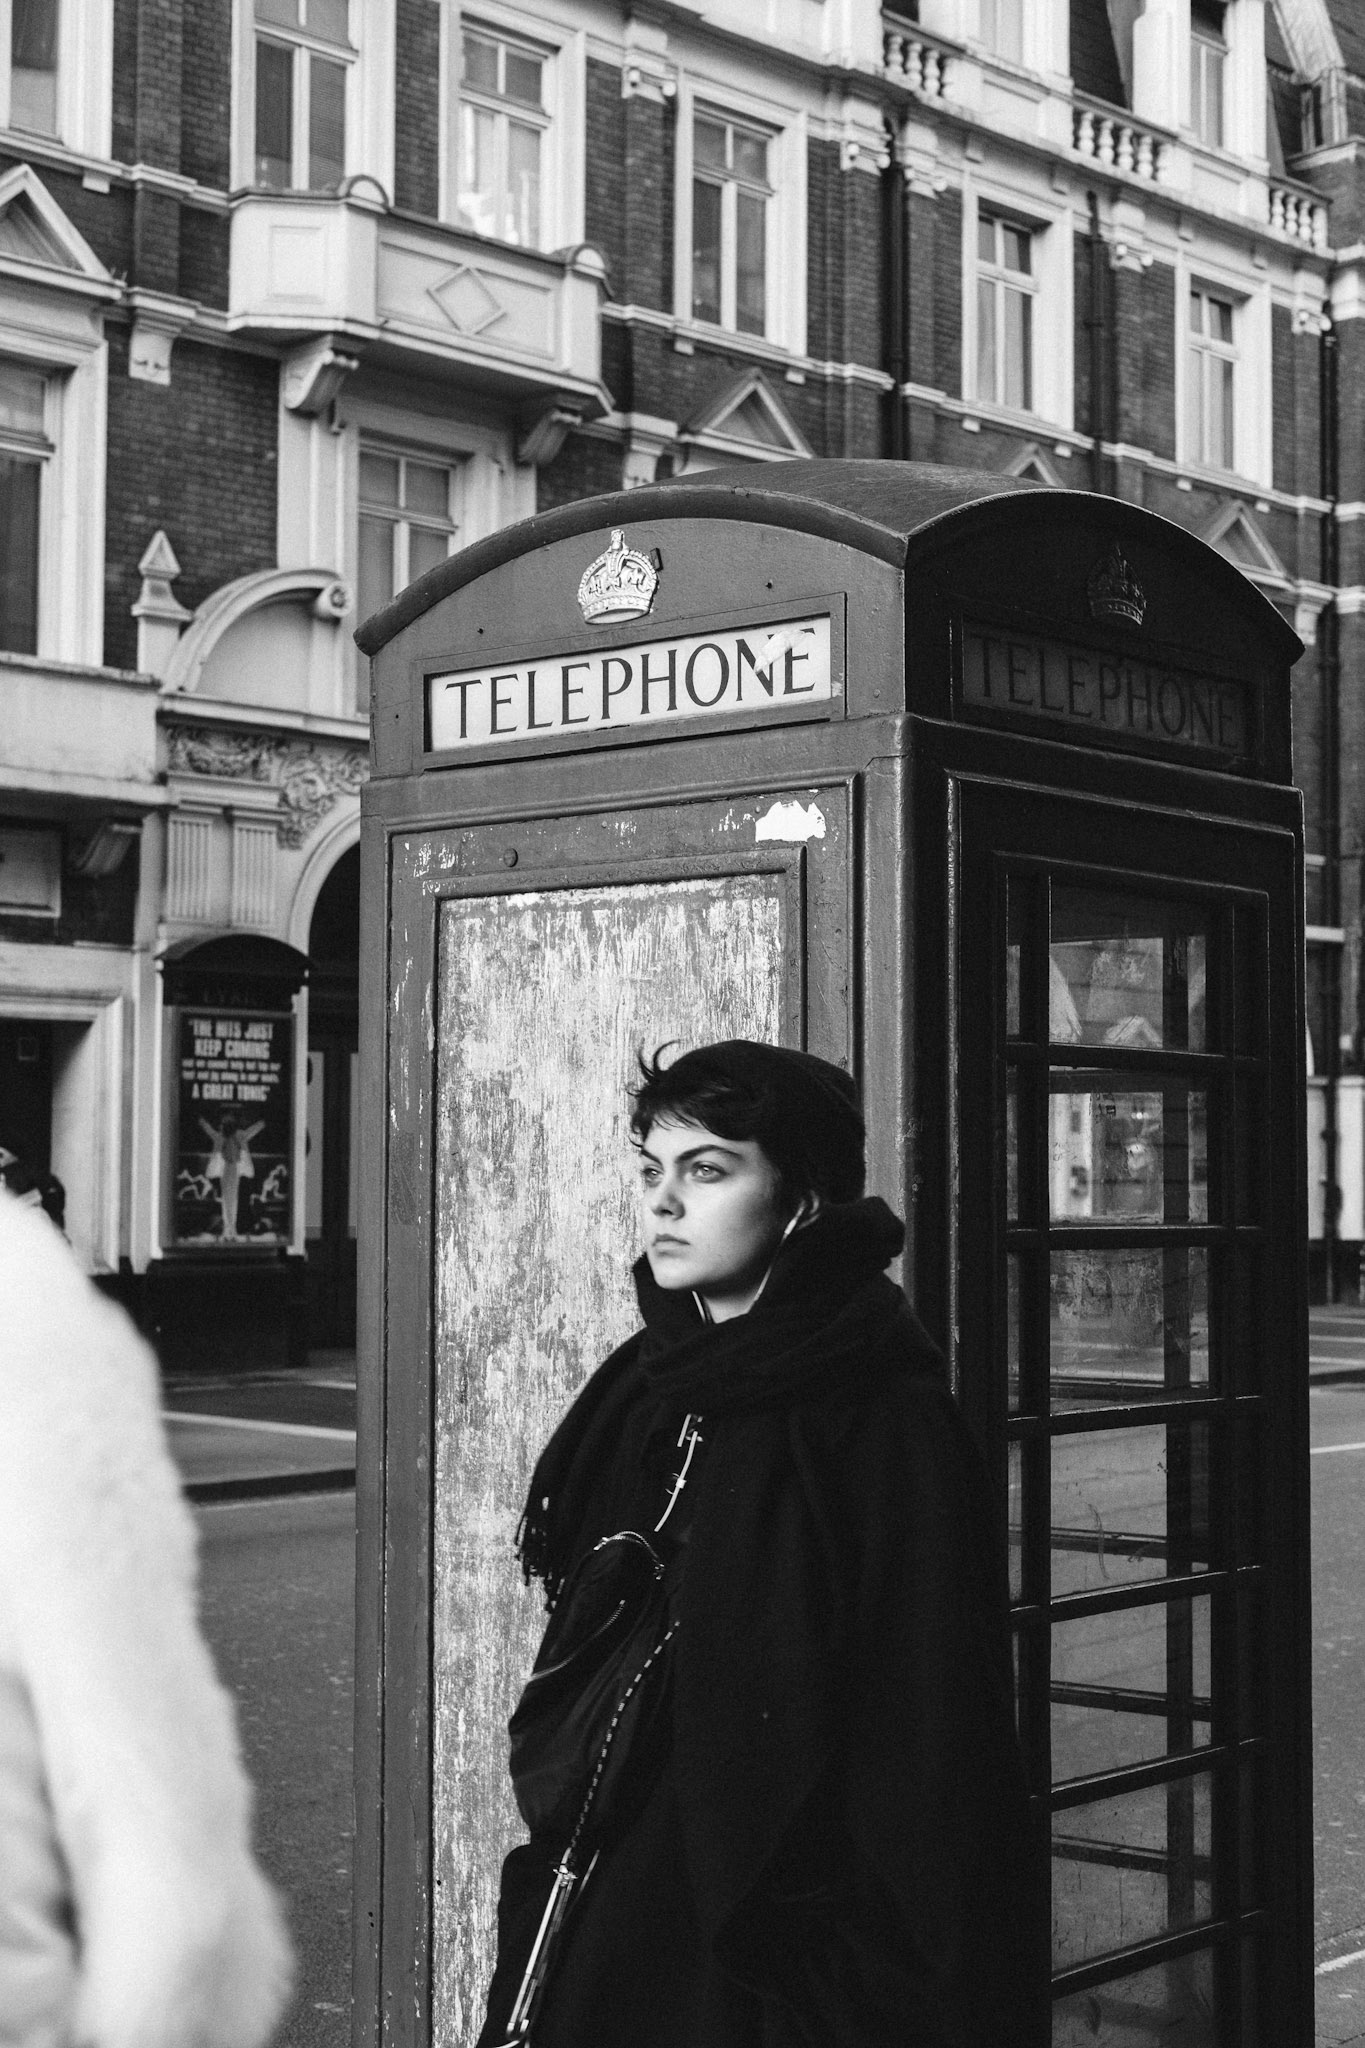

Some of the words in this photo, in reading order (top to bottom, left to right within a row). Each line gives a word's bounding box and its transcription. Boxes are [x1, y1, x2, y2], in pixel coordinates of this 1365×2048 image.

[445, 628, 816, 739] TELEPHONE
[971, 633, 1239, 749] TELEPHONE
[244, 1022, 273, 1041] JUST
[194, 1038, 222, 1057] KEEP
[192, 1083, 200, 1099] A
[202, 1083, 234, 1101] GREAT
